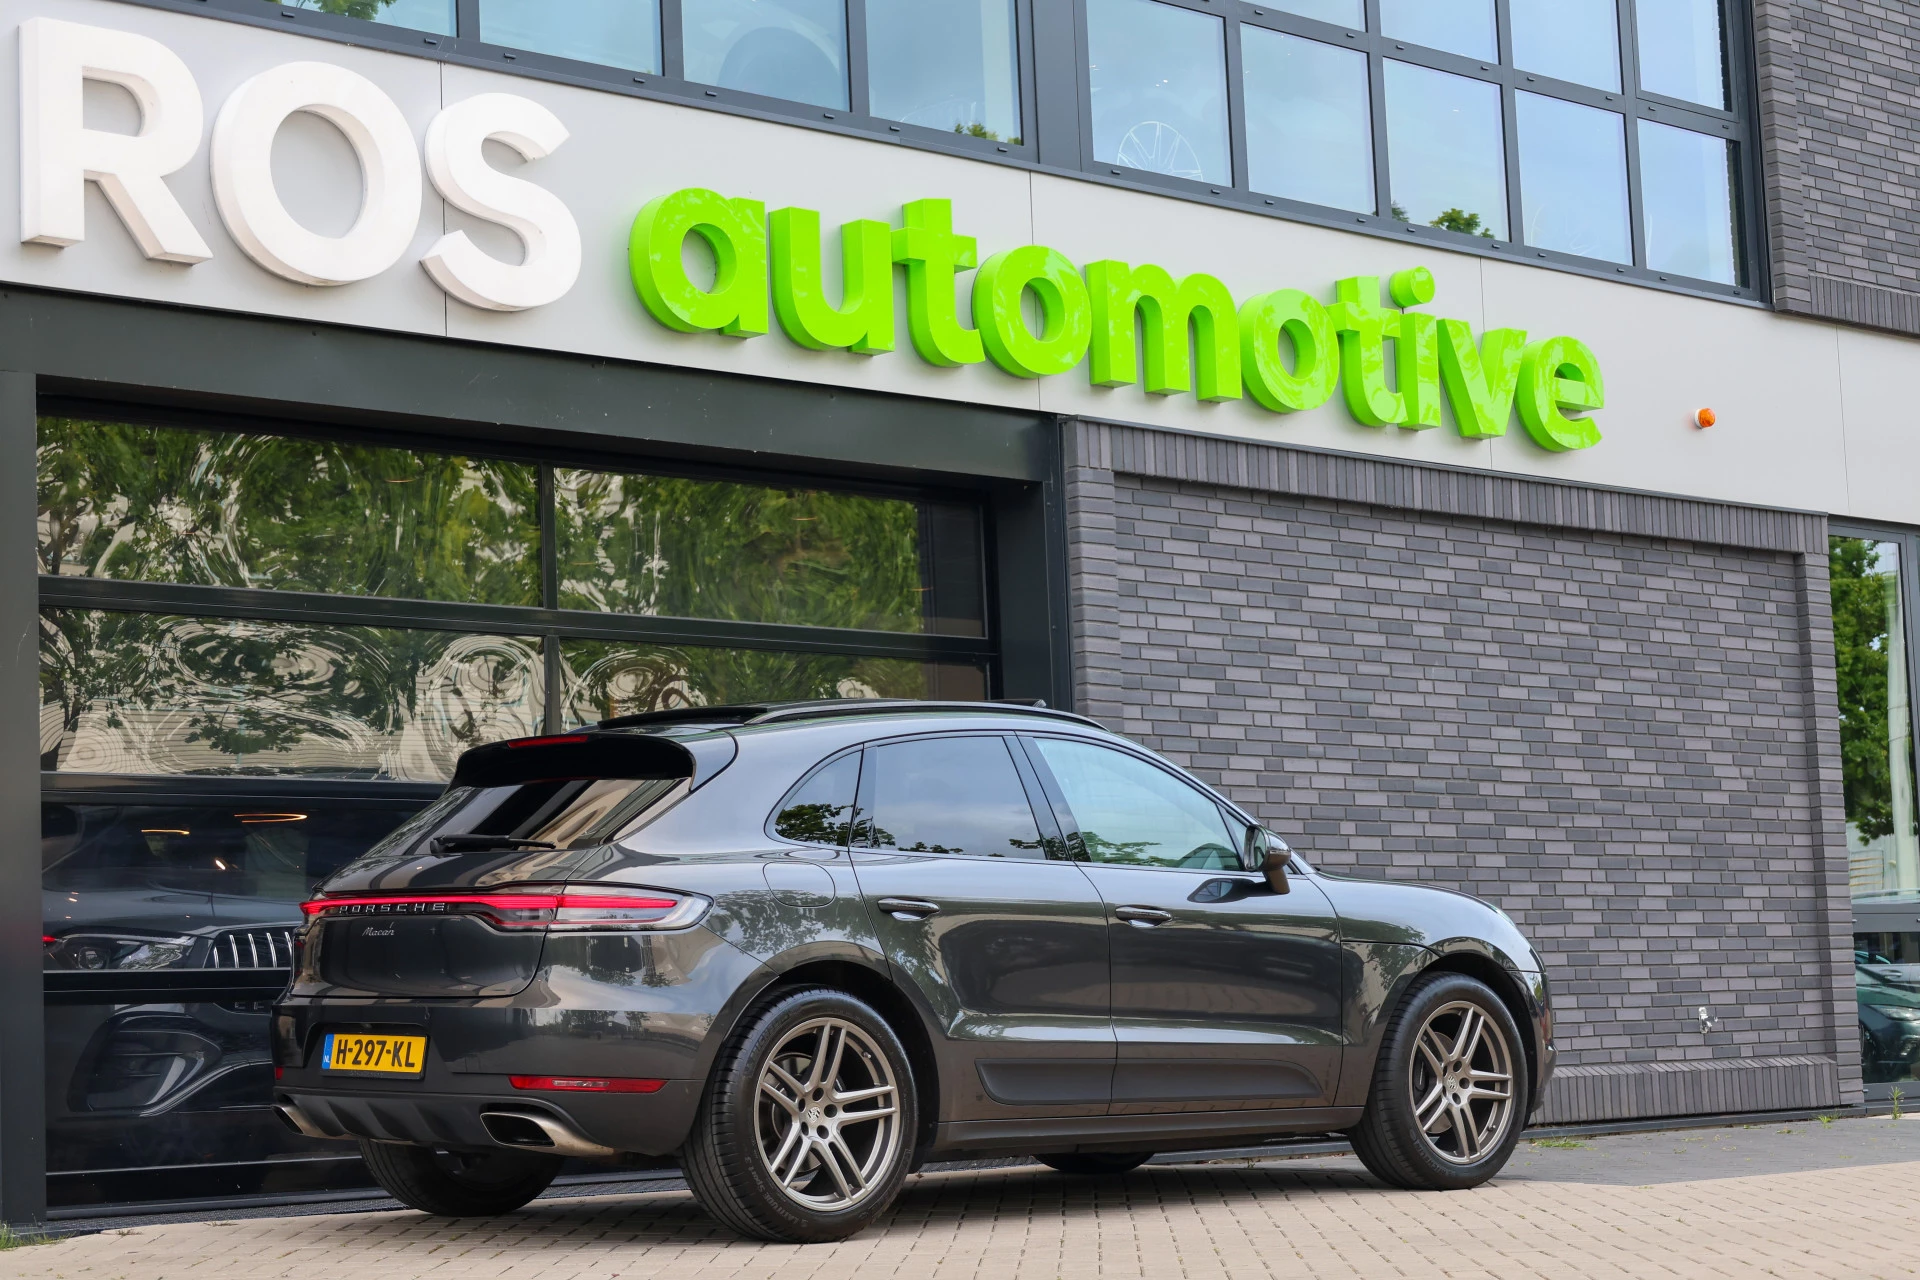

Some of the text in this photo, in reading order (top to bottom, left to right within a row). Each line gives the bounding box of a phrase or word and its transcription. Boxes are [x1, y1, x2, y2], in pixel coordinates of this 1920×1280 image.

[18, 16, 1604, 453] ROS automotive
[339, 902, 446, 914] PORSCHE
[362, 925, 395, 937] Macan
[323, 1055, 330, 1063] NL
[336, 1039, 415, 1067] H-297-KL
[747, 1165, 766, 1193] Sport
[761, 1190, 799, 1226] LATITUDE
